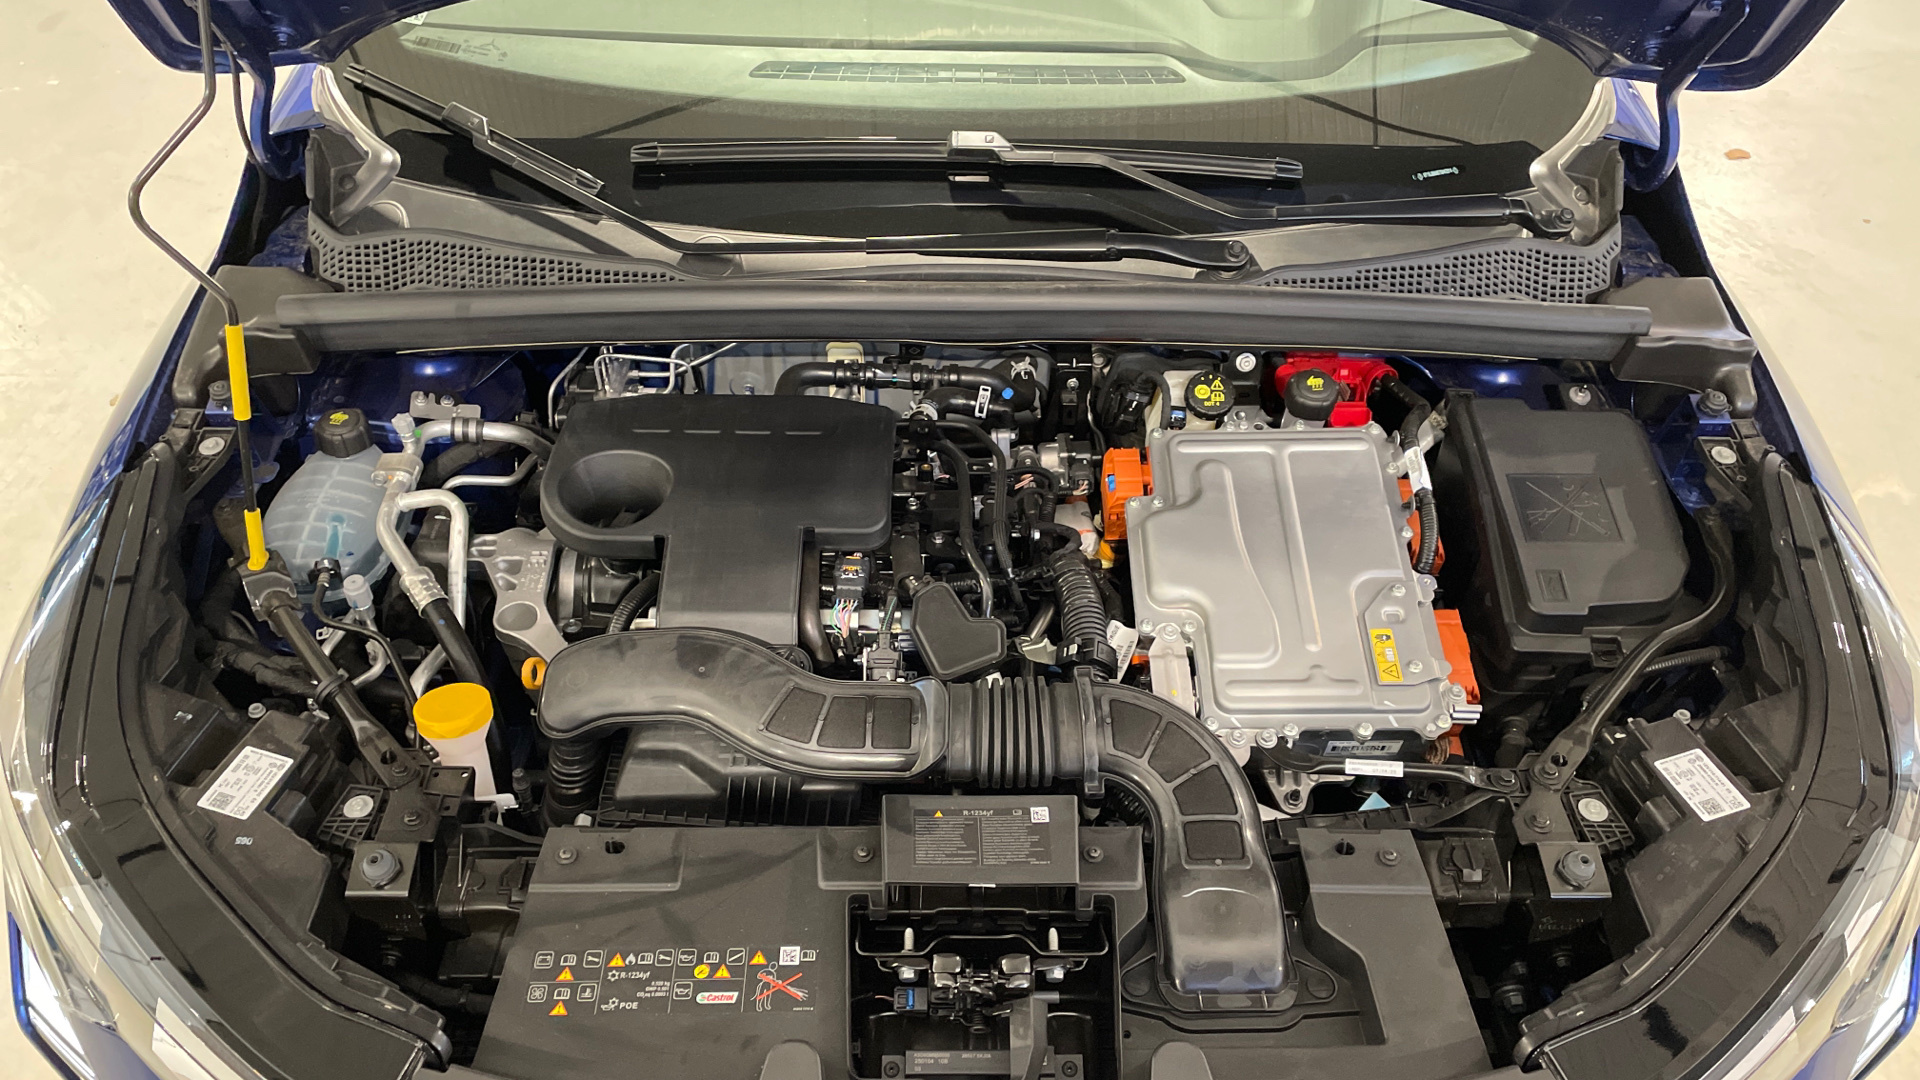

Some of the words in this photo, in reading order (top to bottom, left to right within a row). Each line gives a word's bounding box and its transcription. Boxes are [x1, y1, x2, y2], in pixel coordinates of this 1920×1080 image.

[962, 809, 994, 817] R-1234yf
[620, 970, 651, 979] R-1234yf
[706, 993, 736, 1001] Castrol
[619, 1002, 639, 1010] POE
